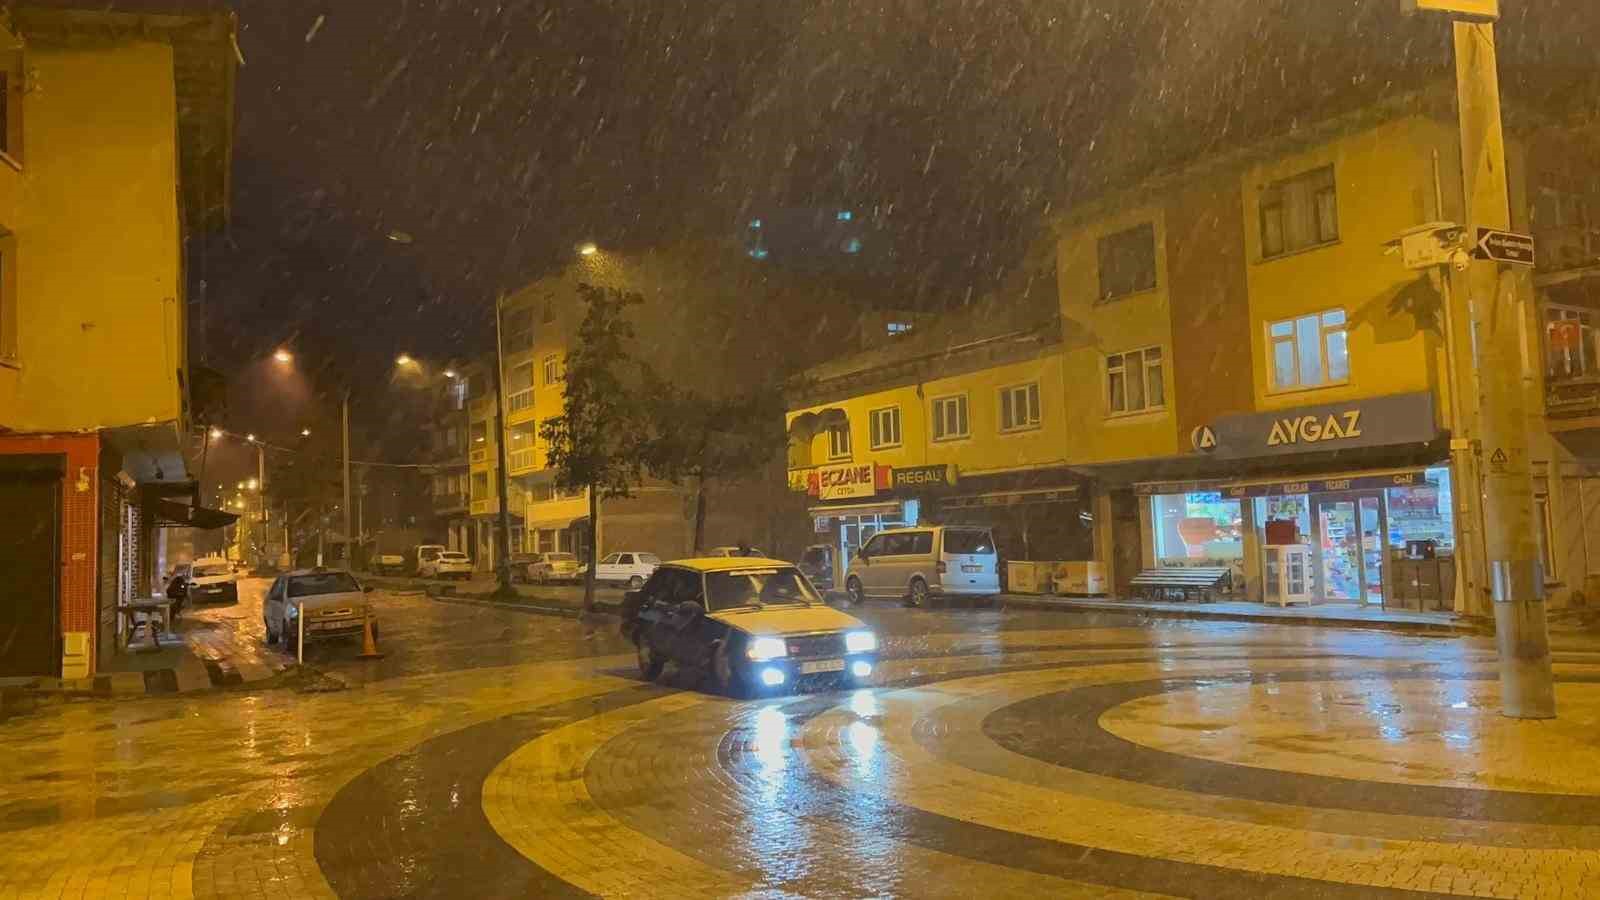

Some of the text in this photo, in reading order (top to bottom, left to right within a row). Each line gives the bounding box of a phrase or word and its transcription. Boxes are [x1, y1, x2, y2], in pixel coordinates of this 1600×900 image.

[1267, 410, 1362, 446] AYGAZ
[821, 465, 871, 487] ECZANE
[896, 470, 940, 483] REGAL
